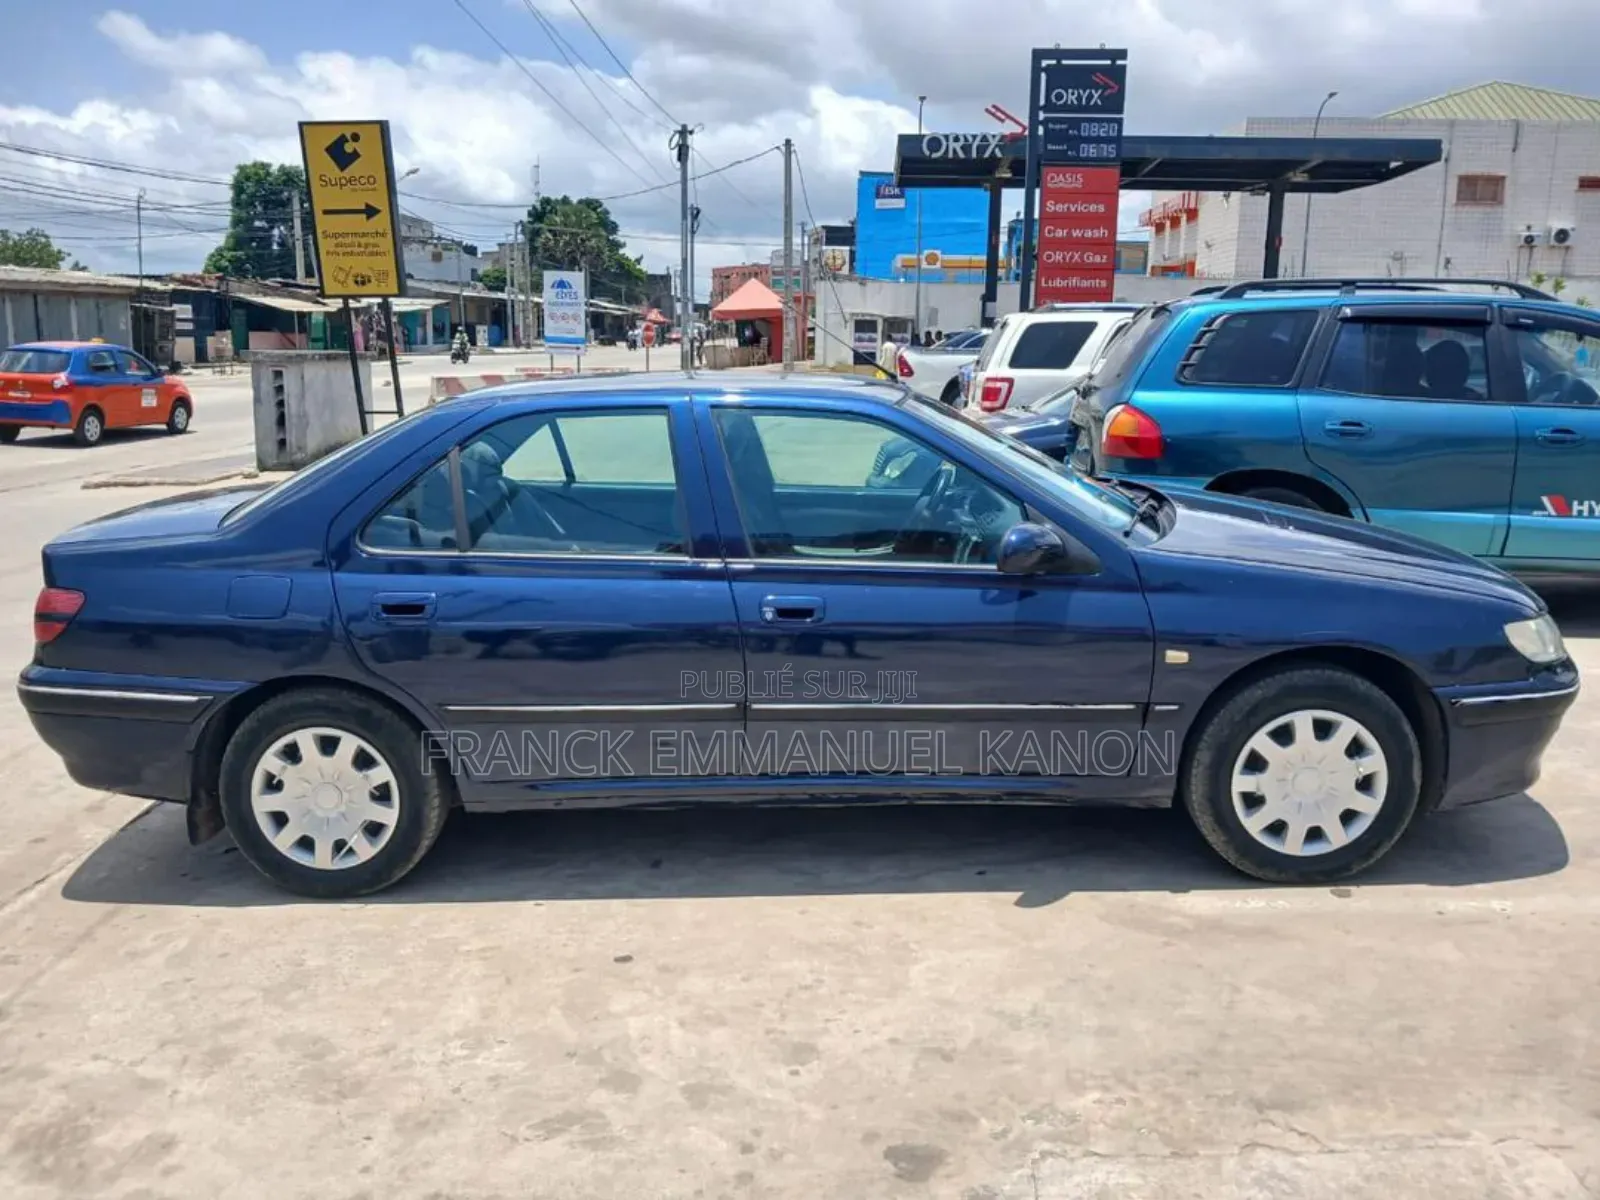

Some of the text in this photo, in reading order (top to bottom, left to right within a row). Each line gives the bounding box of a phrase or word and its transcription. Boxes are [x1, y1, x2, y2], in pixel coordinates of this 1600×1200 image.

[1051, 88, 1102, 105] ORYX
[1081, 122, 1118, 137] 0820
[922, 132, 1004, 160] ORYX
[1080, 143, 1117, 158] 0675
[319, 174, 377, 190] Supeco
[1047, 172, 1084, 183] OASIS
[1046, 200, 1105, 213] Services
[321, 228, 388, 240] Supermarché
[1044, 226, 1109, 239] Car wash
[1043, 251, 1108, 263] ORYX Gaz
[1041, 276, 1107, 288] Lubrifiants
